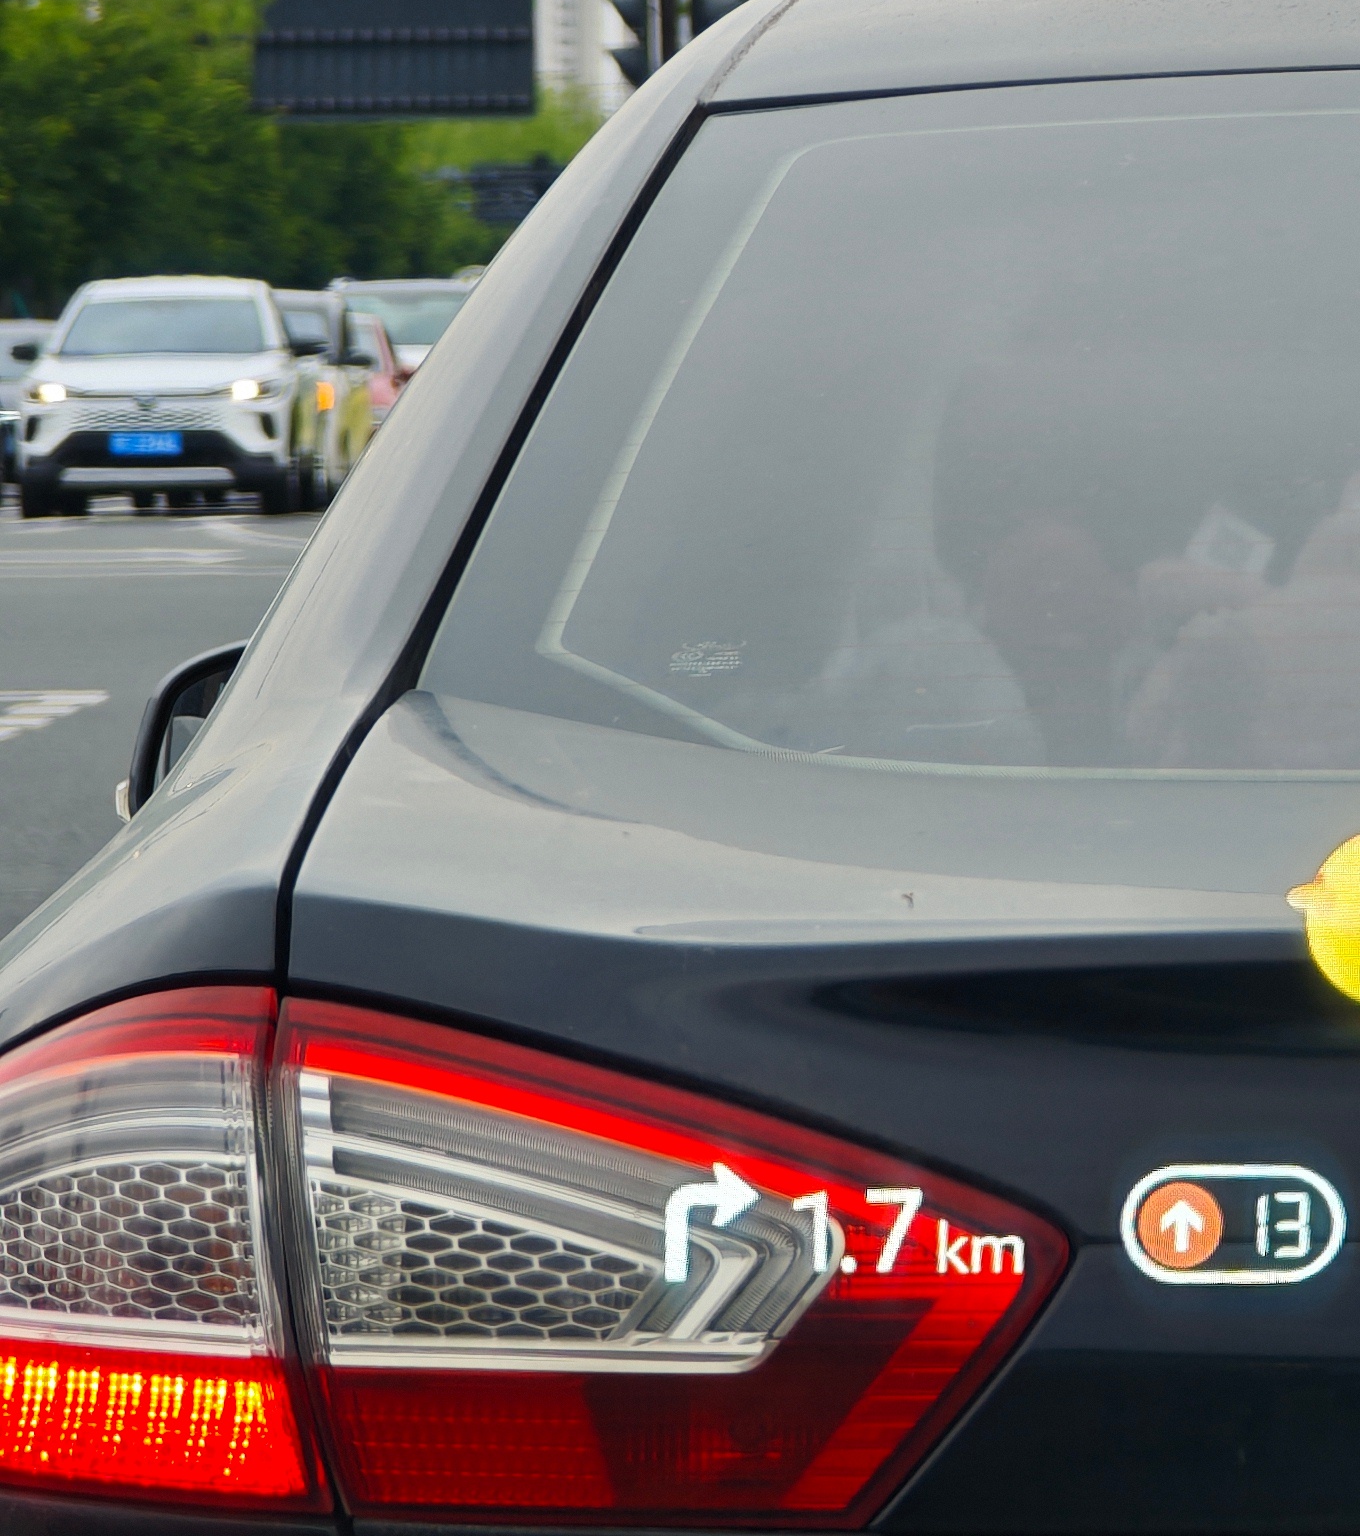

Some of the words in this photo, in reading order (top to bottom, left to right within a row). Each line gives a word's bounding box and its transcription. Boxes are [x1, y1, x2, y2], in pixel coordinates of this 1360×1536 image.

[793, 1187, 924, 1274] 1.7
[937, 1219, 1026, 1275] km
[1255, 1191, 1312, 1259] 13
